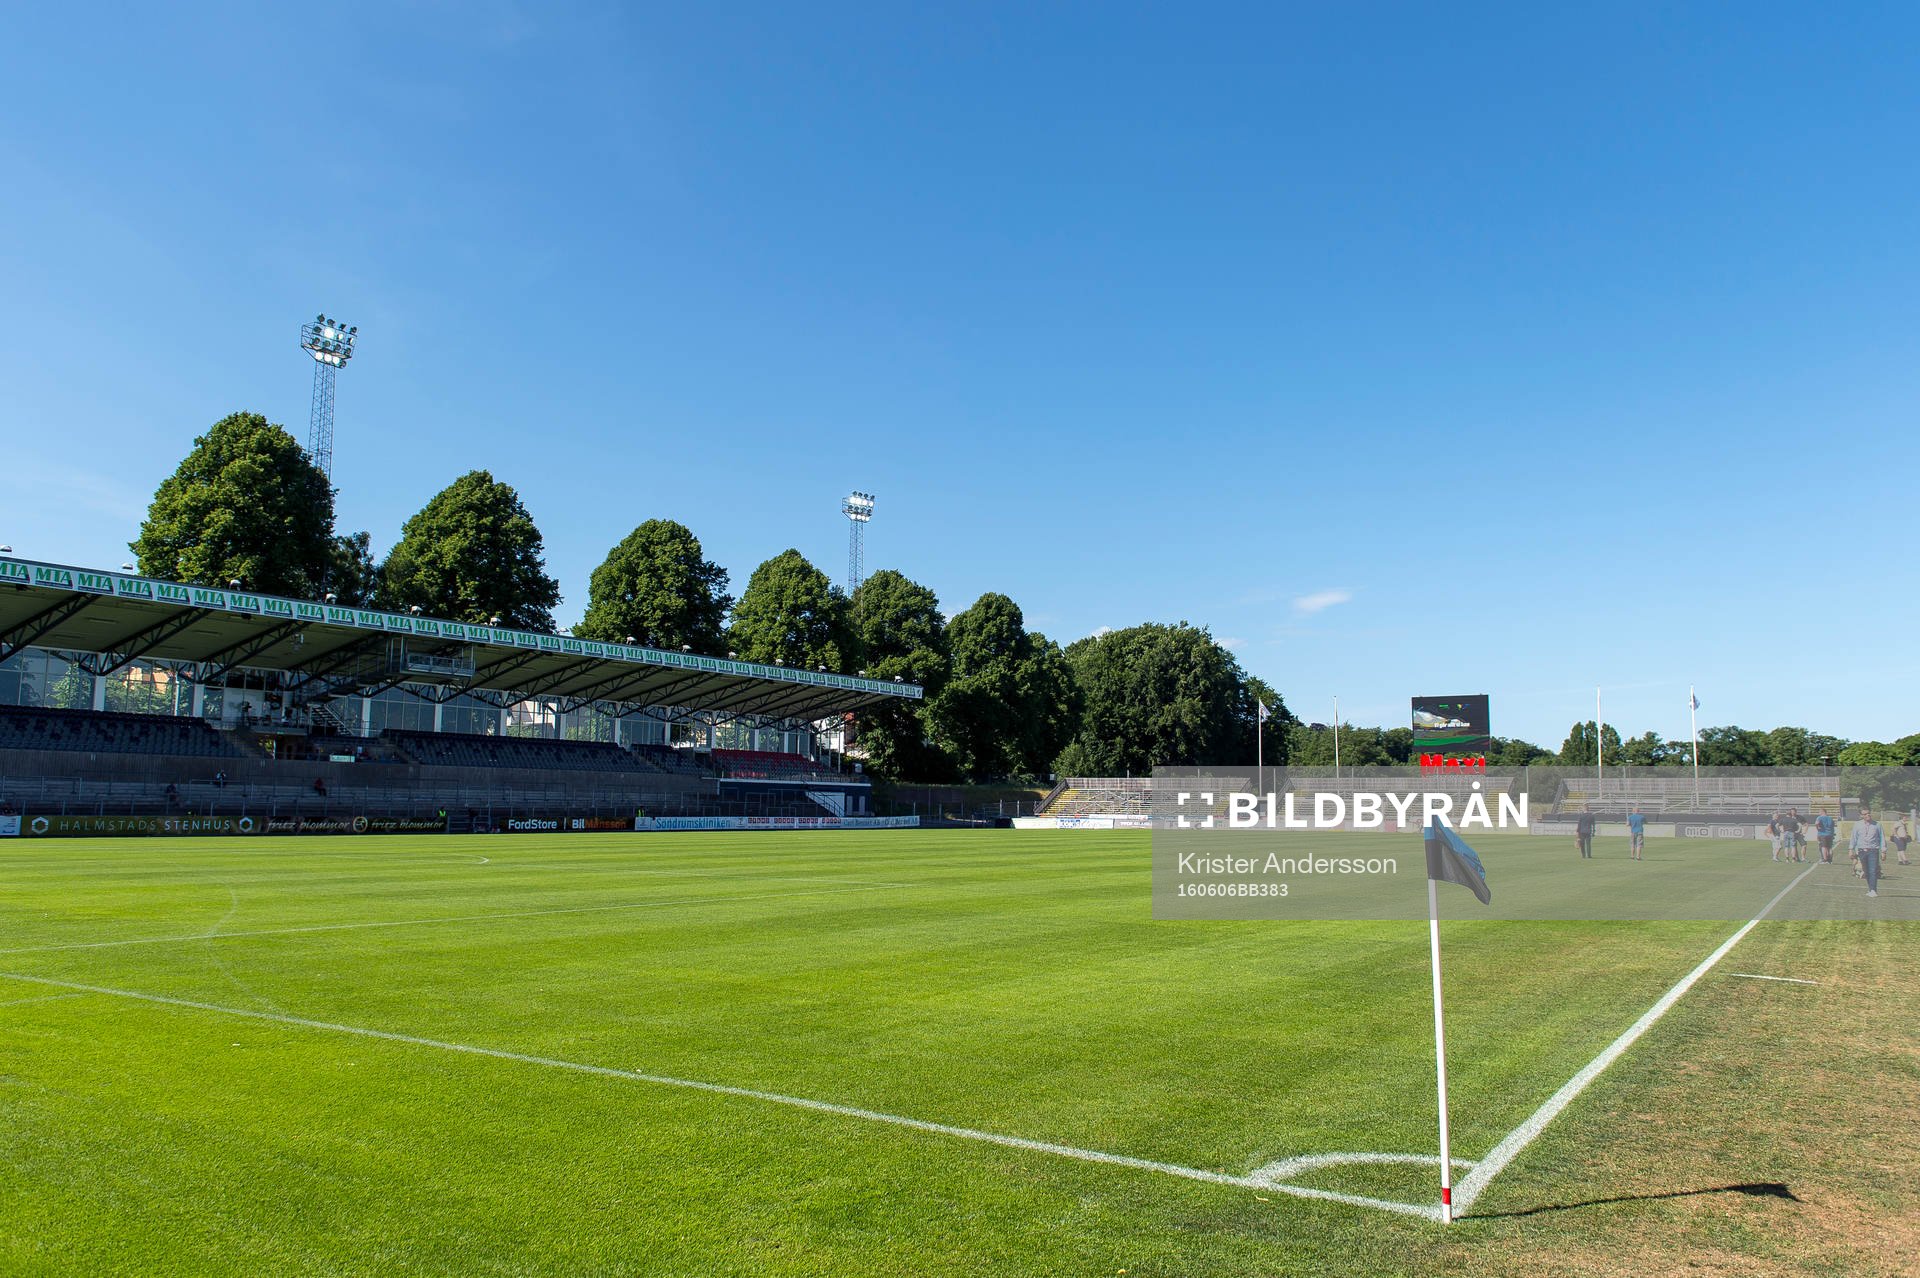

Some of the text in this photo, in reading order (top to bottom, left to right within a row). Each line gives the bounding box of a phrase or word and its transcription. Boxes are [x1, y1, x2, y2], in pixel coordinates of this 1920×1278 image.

[36, 567, 71, 585] MTA
[78, 573, 112, 590] MTA
[119, 578, 151, 594] MTA
[158, 584, 189, 600] MTA
[194, 590, 224, 604] MTA
[230, 594, 259, 609] MTA
[264, 599, 291, 614] MTA
[298, 604, 324, 618] MTA
[328, 608, 354, 621] MTA
[358, 612, 383, 626] MTA
[387, 616, 411, 628] MTA
[416, 620, 438, 632] MTA
[442, 623, 465, 635] MTA
[468, 627, 490, 638] MTA
[494, 630, 514, 641] MTA
[518, 634, 537, 644] MTA
[540, 636, 560, 648] MTA
[564, 640, 582, 650] MTA
[584, 642, 602, 652] MTA
[60, 820, 231, 831] HALMSTADS STENHUS
[508, 819, 557, 830] FordStore
